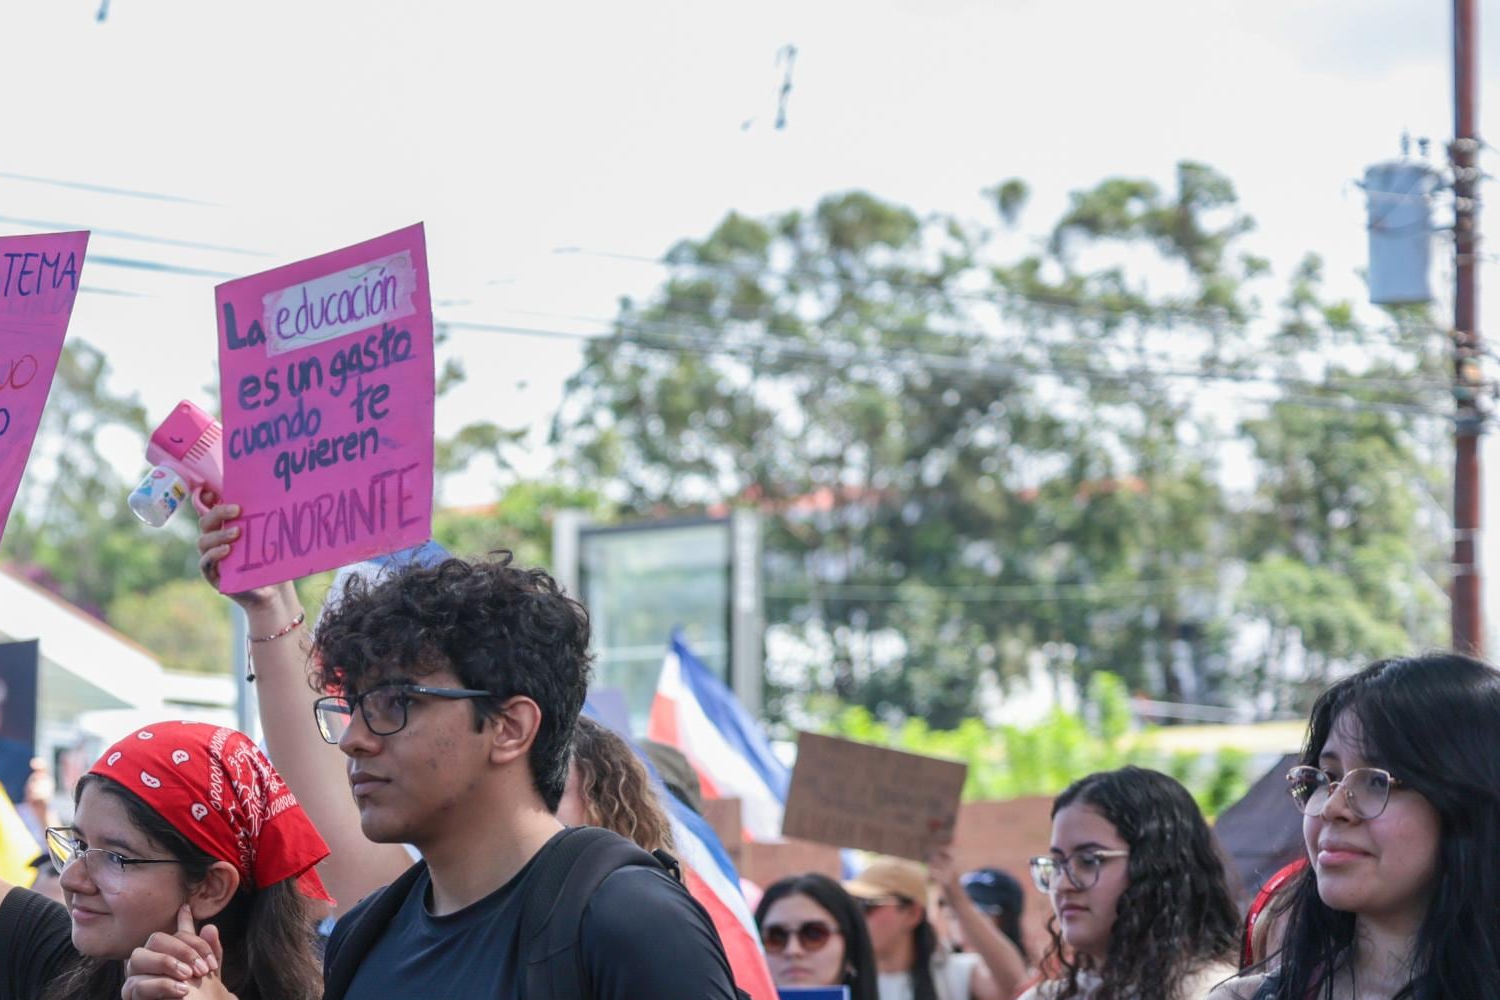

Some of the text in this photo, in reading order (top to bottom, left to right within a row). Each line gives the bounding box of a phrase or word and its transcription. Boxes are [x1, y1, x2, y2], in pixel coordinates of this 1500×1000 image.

[223, 267, 397, 350] La educación
[238, 322, 412, 410] es un gasto
[229, 375, 390, 460] cuando te
[274, 427, 379, 492] quieren
[236, 462, 423, 573] IGNORANTE
